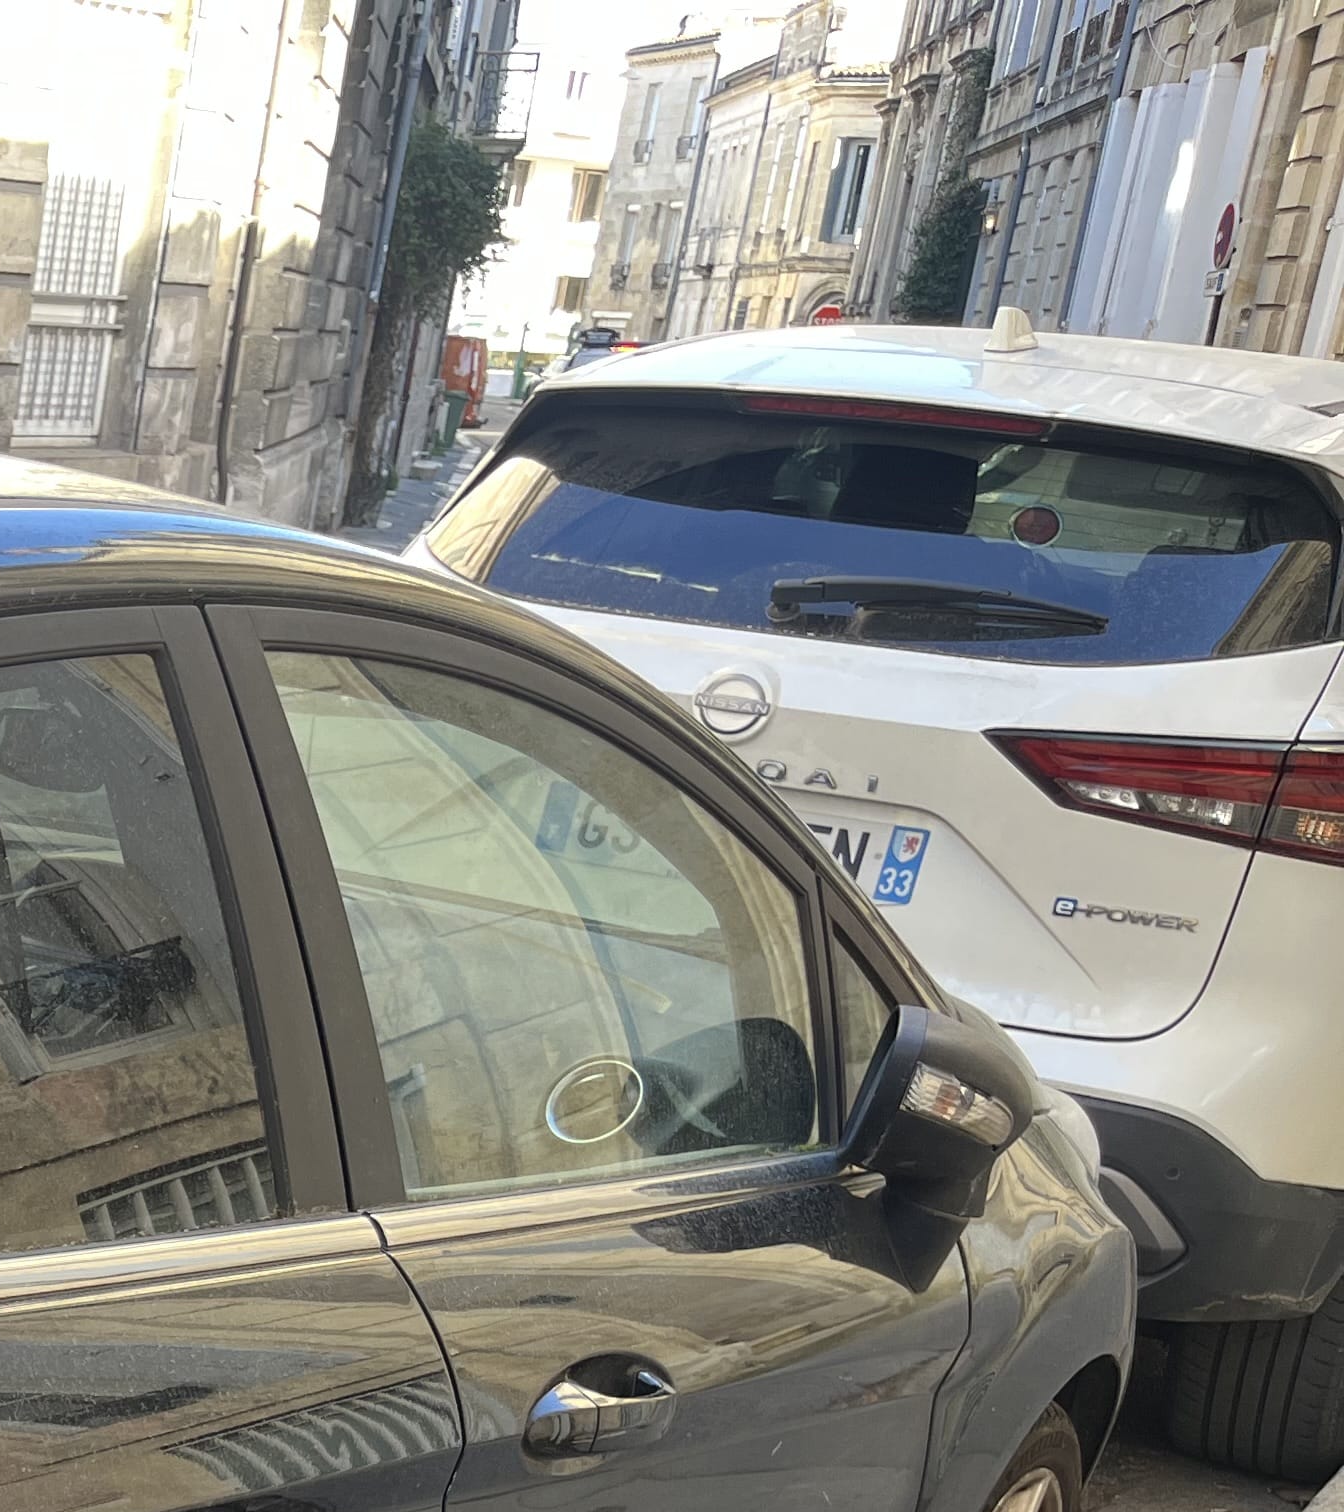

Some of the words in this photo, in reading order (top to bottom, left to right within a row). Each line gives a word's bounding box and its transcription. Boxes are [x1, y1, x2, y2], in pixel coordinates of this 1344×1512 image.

[695, 692, 770, 715] NISSAN
[807, 823, 871, 881] N
[878, 867, 914, 898] 33
[1054, 898, 1199, 933] e-POWER
